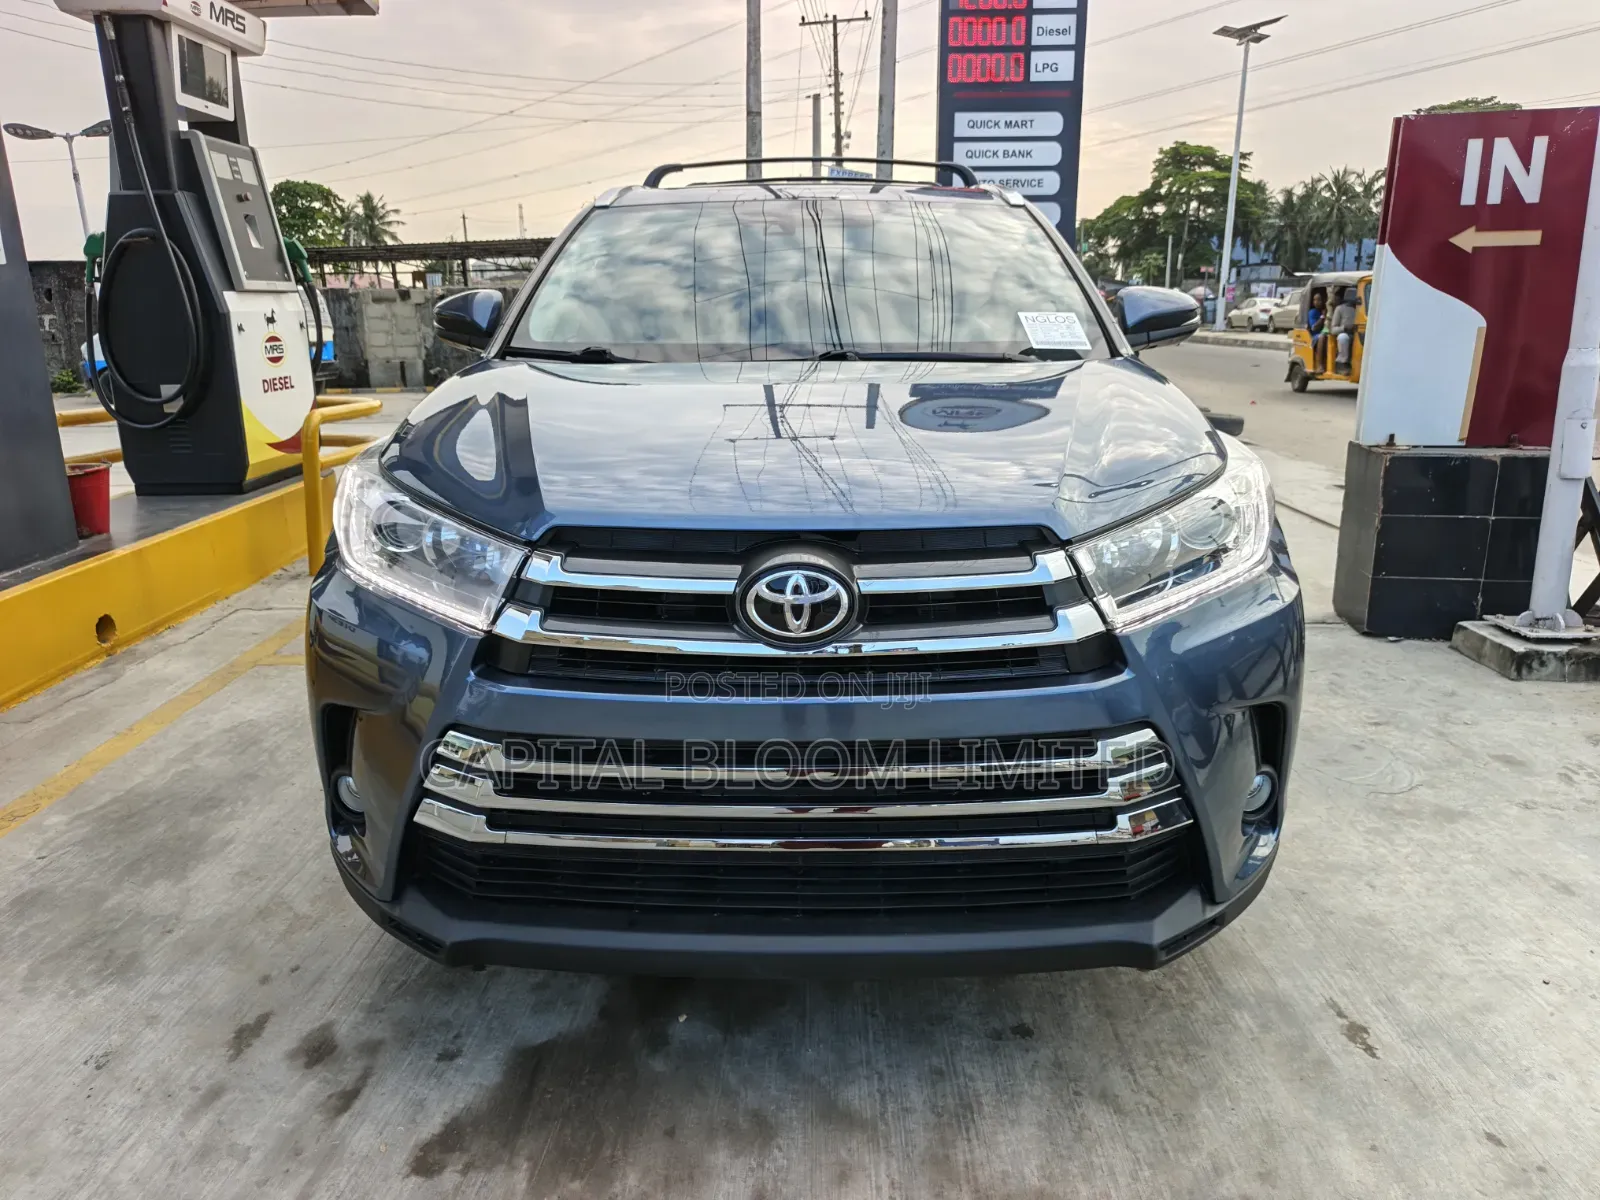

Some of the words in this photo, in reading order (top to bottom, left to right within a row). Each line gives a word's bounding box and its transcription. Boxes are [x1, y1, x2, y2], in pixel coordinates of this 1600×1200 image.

[210, 1, 246, 34] MRS
[1036, 26, 1071, 37] Diesel
[947, 53, 1025, 83] 0000.0
[1034, 63, 1059, 73] LPG
[967, 120, 1001, 130] QUICK
[1004, 119, 1035, 129] MART
[965, 150, 999, 159] QUICK
[1002, 149, 1033, 159] BANK
[1460, 135, 1549, 205] IN
[998, 178, 1044, 188] SERVICE
[1024, 315, 1076, 324] NGLOS
[264, 343, 285, 355] MRS
[262, 375, 295, 393] DIESEL
